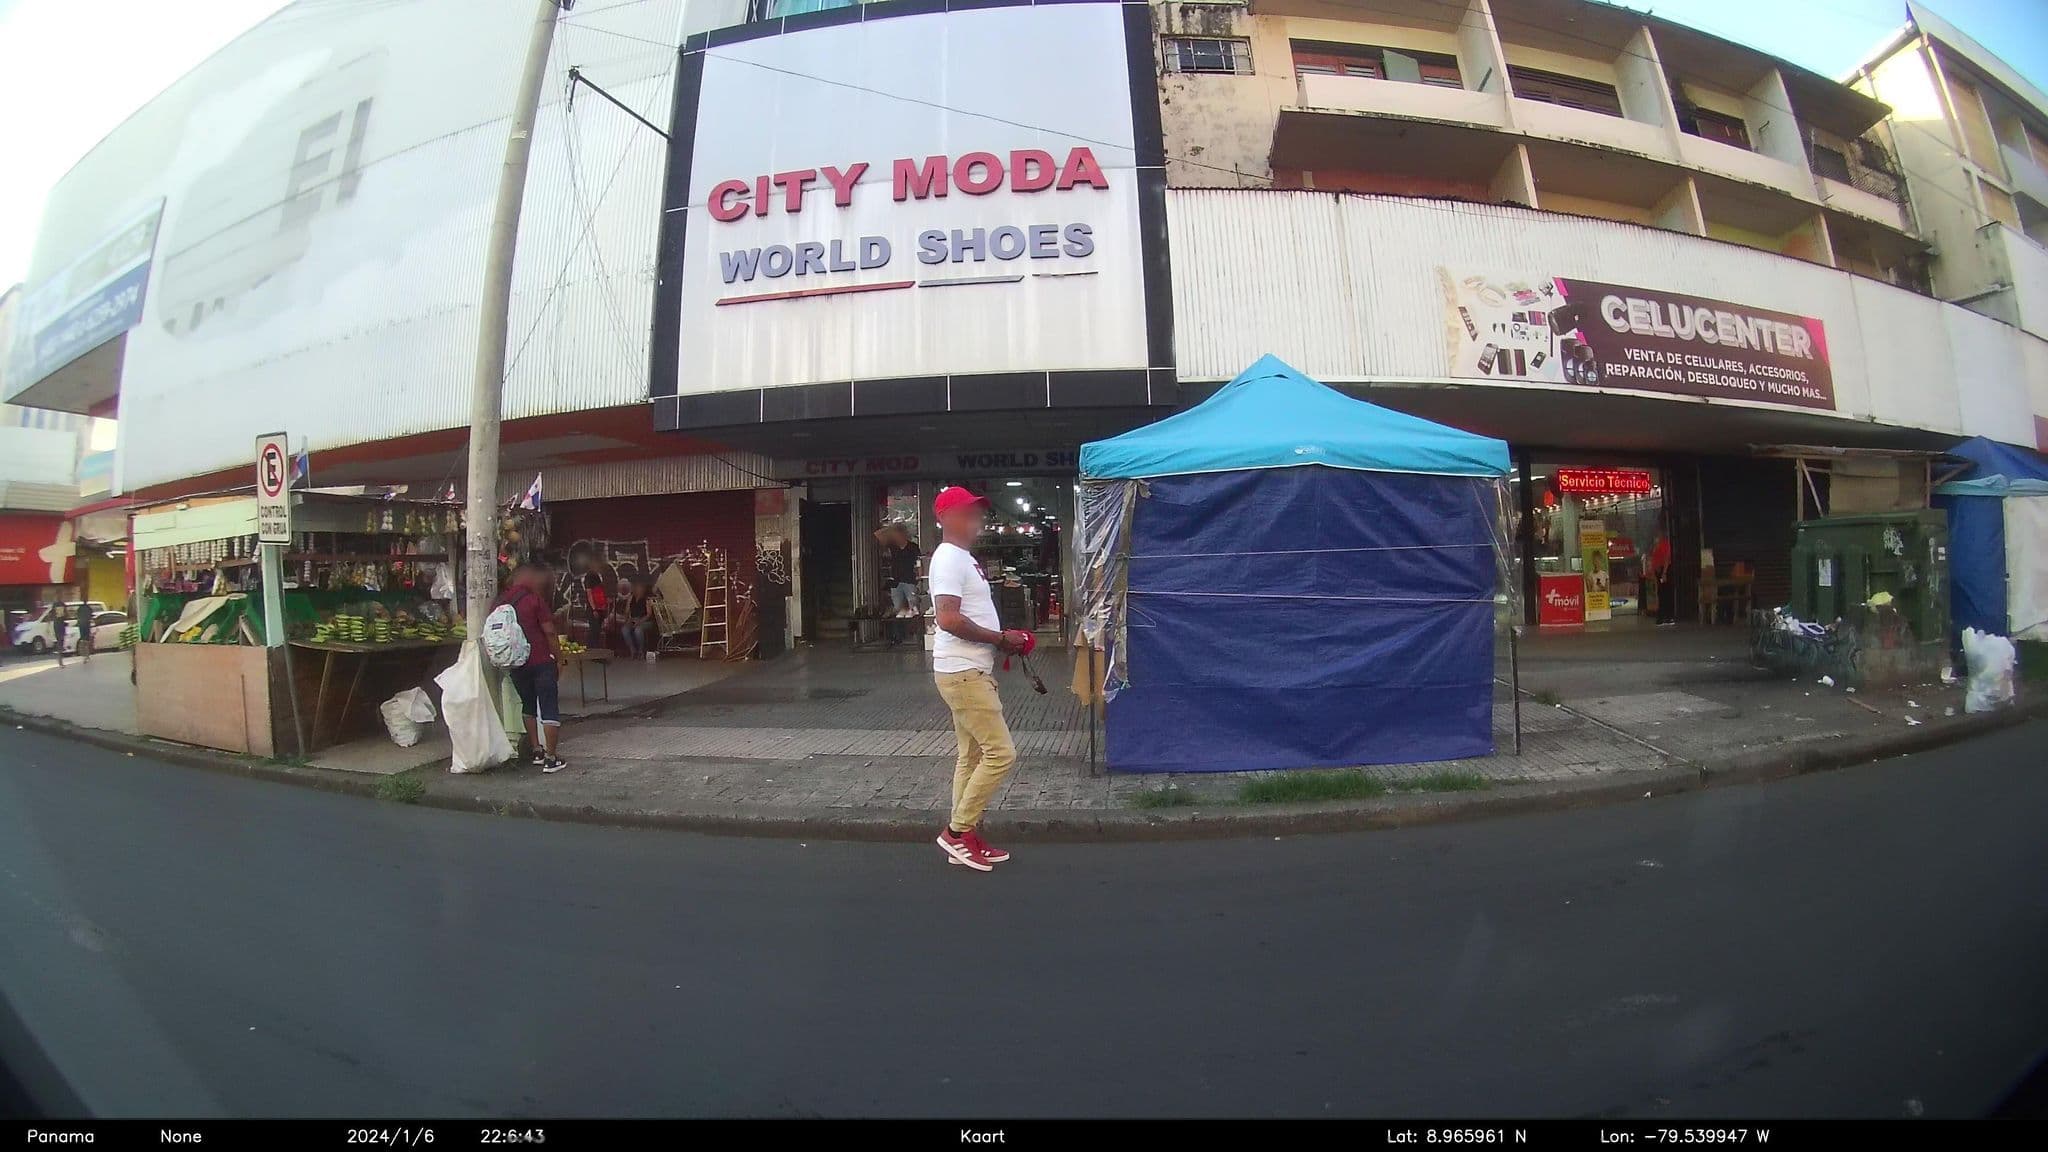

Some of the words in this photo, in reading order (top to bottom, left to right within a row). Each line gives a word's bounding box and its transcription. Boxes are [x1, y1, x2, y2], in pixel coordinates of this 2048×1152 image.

[707, 162, 871, 222] CITY
[892, 146, 1109, 202] MODA
[719, 235, 892, 284] WORLD
[916, 222, 1096, 266] SHOES
[1600, 294, 1813, 360] CELUCENTER
[1624, 347, 1664, 364] VENTA
[1666, 351, 1682, 365] DE
[1684, 354, 1747, 374] CELULARES,
[1748, 362, 1809, 384] ACCESORIOS,
[1605, 362, 1686, 384] REPARACIÓN,
[1687, 371, 1757, 391] DESBLOQUEO
[1759, 380, 1766, 392] Y
[1767, 381, 1801, 397] MUCHO
[805, 458, 858, 476] CITY
[957, 452, 1039, 469] WORLD
[1561, 474, 1605, 489] Servicio
[1606, 475, 1648, 490] Técnico
[261, 504, 287, 518] CONTROL
[261, 521, 272, 535] CON
